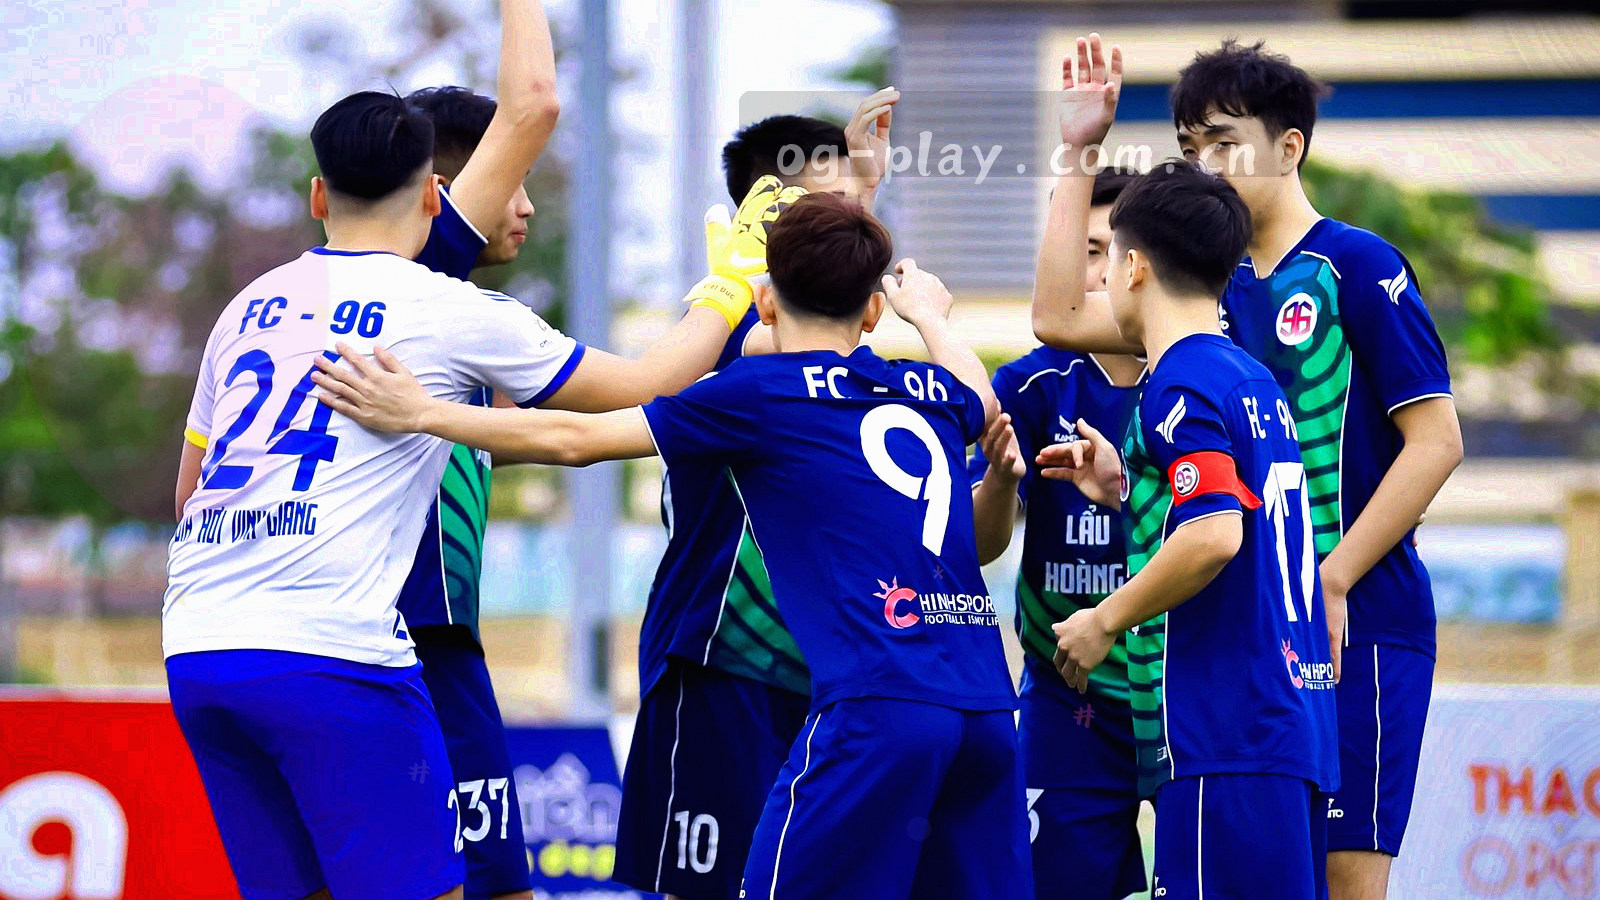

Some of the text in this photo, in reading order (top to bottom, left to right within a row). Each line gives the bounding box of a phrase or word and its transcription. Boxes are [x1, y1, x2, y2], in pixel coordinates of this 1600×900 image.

[239, 296, 288, 335] FC
[329, 300, 386, 339] 96
[802, 365, 852, 399] FC
[903, 369, 948, 402] 96
[202, 349, 342, 492] 24
[1242, 396, 1267, 440] FC
[860, 403, 952, 557] 9
[1065, 504, 1110, 546] LẨU
[1262, 461, 1315, 623] 17
[1044, 557, 1125, 595] HOÀNG
[884, 587, 995, 629] CHINHSPOR
[674, 810, 719, 874] 10
